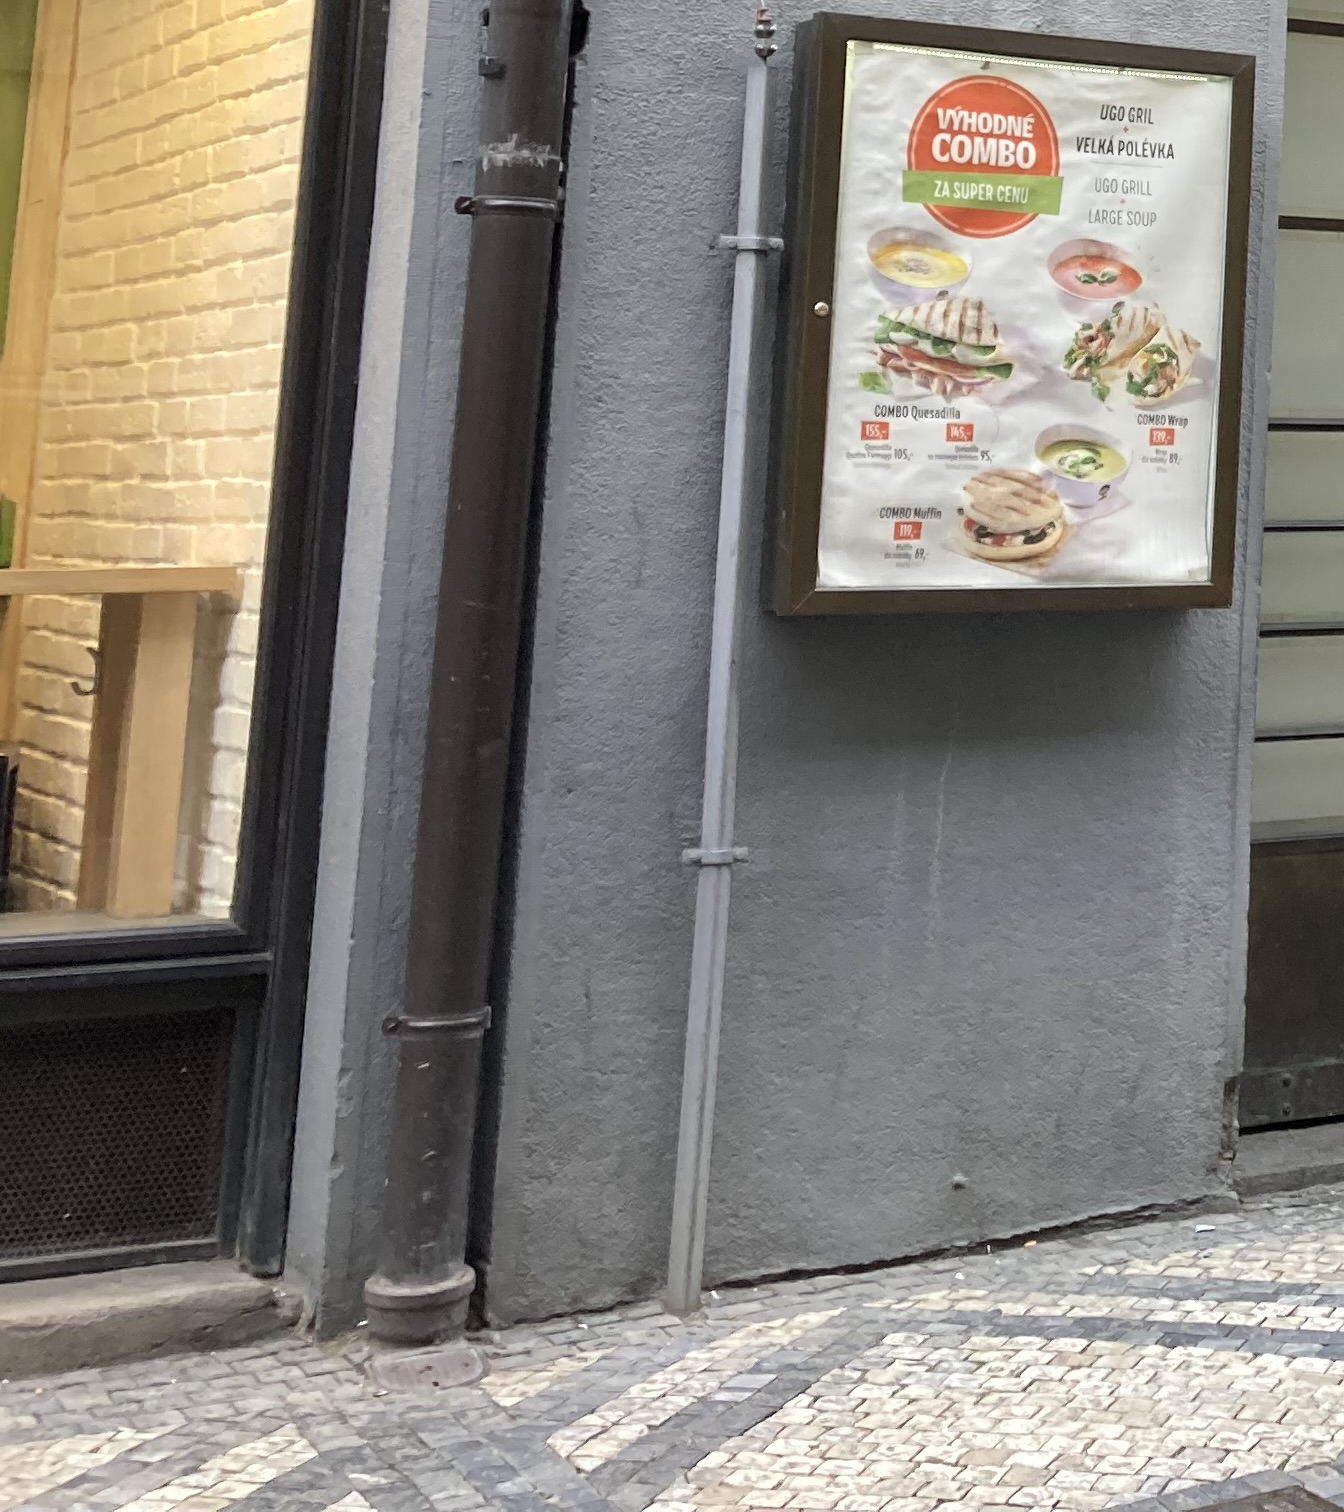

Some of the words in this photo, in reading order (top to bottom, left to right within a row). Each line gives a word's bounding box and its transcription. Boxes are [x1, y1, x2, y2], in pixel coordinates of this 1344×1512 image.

[937, 106, 1035, 138] VÝHODNÉ
[1100, 104, 1125, 122] UGO
[1128, 107, 1154, 125] GRIL
[931, 133, 1037, 170] COMBO
[1076, 135, 1114, 155] VELKÁ
[1118, 137, 1174, 160] POLÉVKA
[934, 180, 950, 198] ZA
[953, 182, 993, 202] SUPER
[997, 186, 1029, 204] CENU
[1095, 177, 1118, 194] UGO
[1122, 179, 1152, 196] GRILL
[1088, 208, 1124, 226] LARGE
[1126, 211, 1157, 227] SOUP
[874, 404, 908, 418] COMBO
[911, 406, 961, 421] Quesadilla
[1137, 414, 1166, 426] COMBO
[1168, 415, 1189, 428] Wrap
[880, 507, 912, 519] COMBO
[913, 507, 942, 519] Muffin
